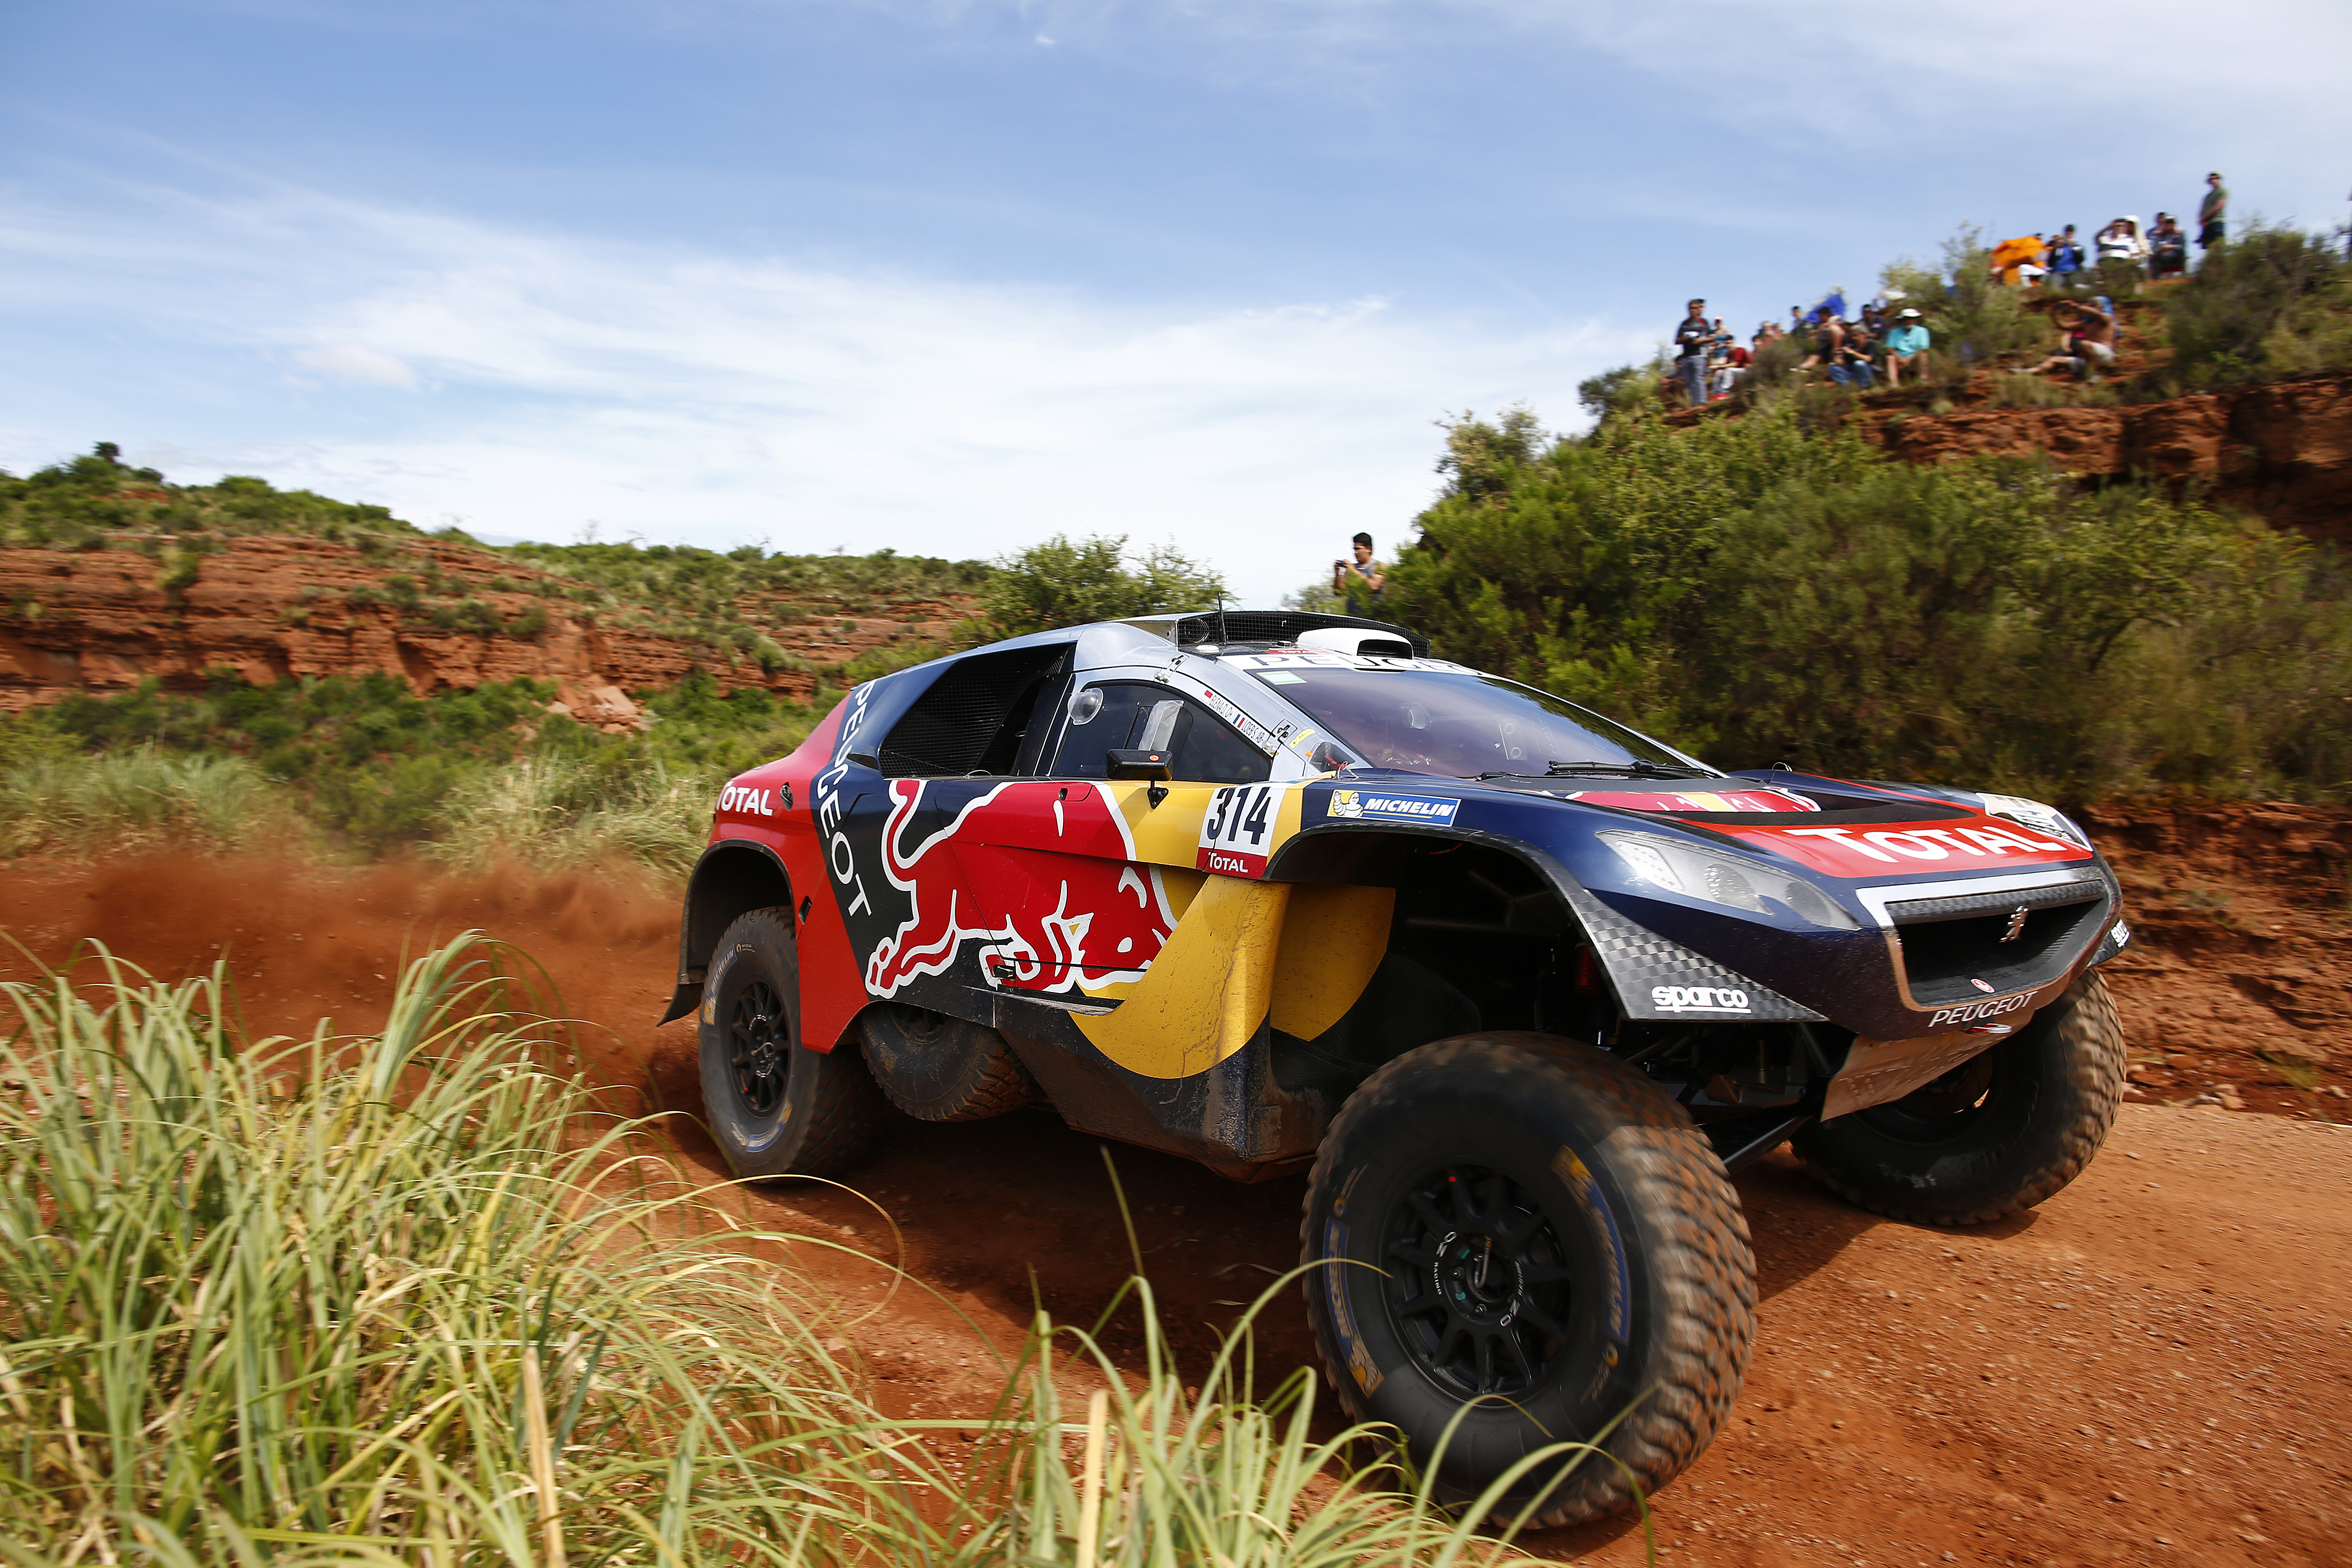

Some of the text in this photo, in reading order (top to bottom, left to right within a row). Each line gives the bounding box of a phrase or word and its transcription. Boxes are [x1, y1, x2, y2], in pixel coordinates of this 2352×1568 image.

[1250, 655, 1501, 679] PEUGEO
[1209, 695, 1225, 712] ELENA
[1241, 719, 1255, 736] LOEB
[717, 781, 774, 816] TOTAL
[816, 679, 877, 916] PEUGEOT
[1365, 798, 1455, 817] MICHELIN
[1207, 786, 1271, 845] 314
[1782, 826, 2068, 863] TOTAL
[1208, 852, 1249, 873] TOTAL
[1652, 986, 1749, 1009] sparco
[1929, 990, 2038, 1028] PEUGEOT
[1433, 1231, 1457, 1296] OZ RACING
[1500, 1298, 1521, 1327] OZ
